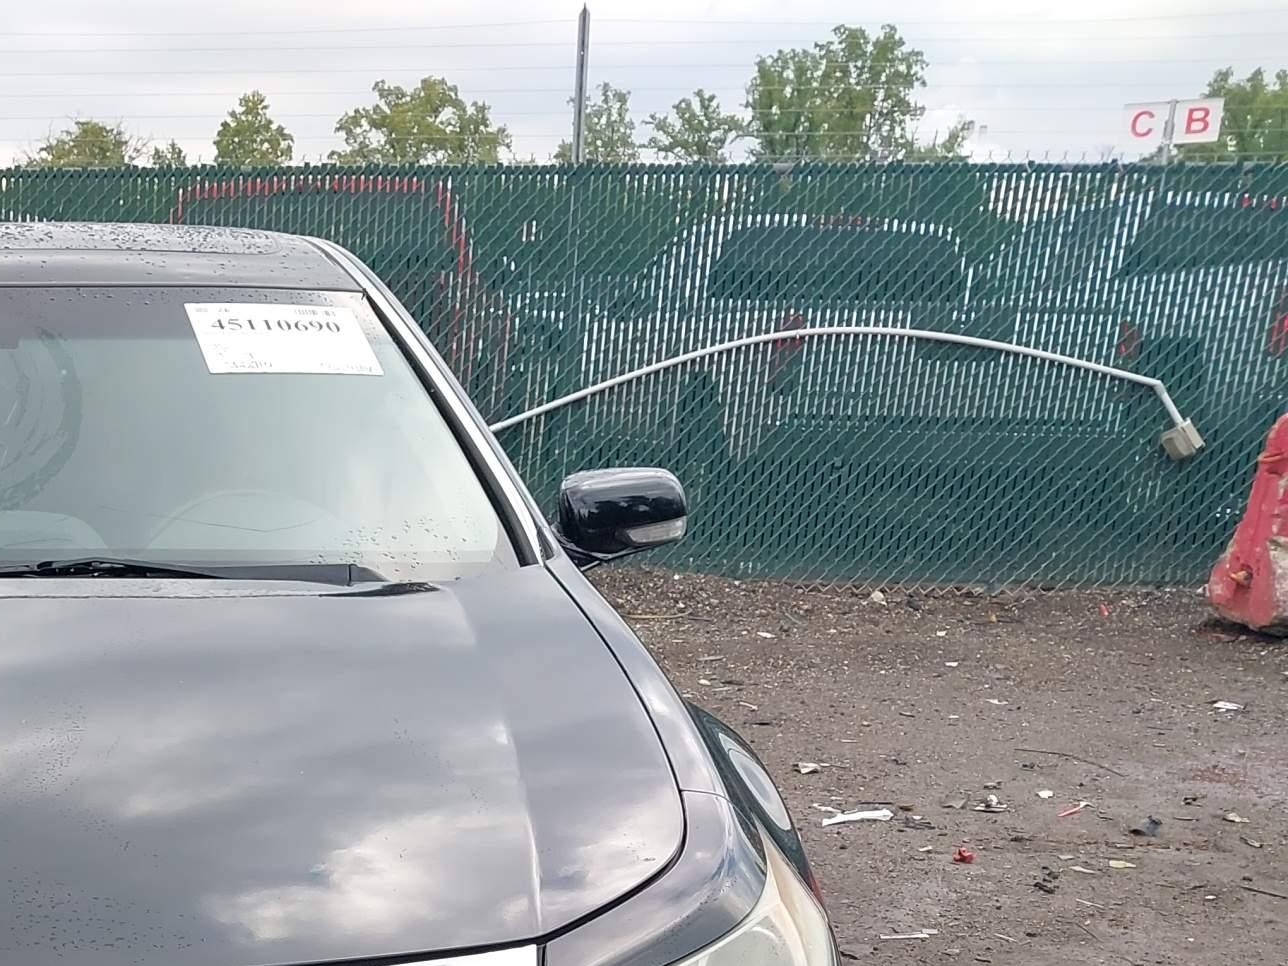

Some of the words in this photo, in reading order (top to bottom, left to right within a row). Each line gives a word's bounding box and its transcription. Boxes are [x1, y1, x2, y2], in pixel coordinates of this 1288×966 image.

[1131, 110, 1155, 138] C
[1185, 107, 1210, 135] B
[210, 318, 341, 333] 45110690
